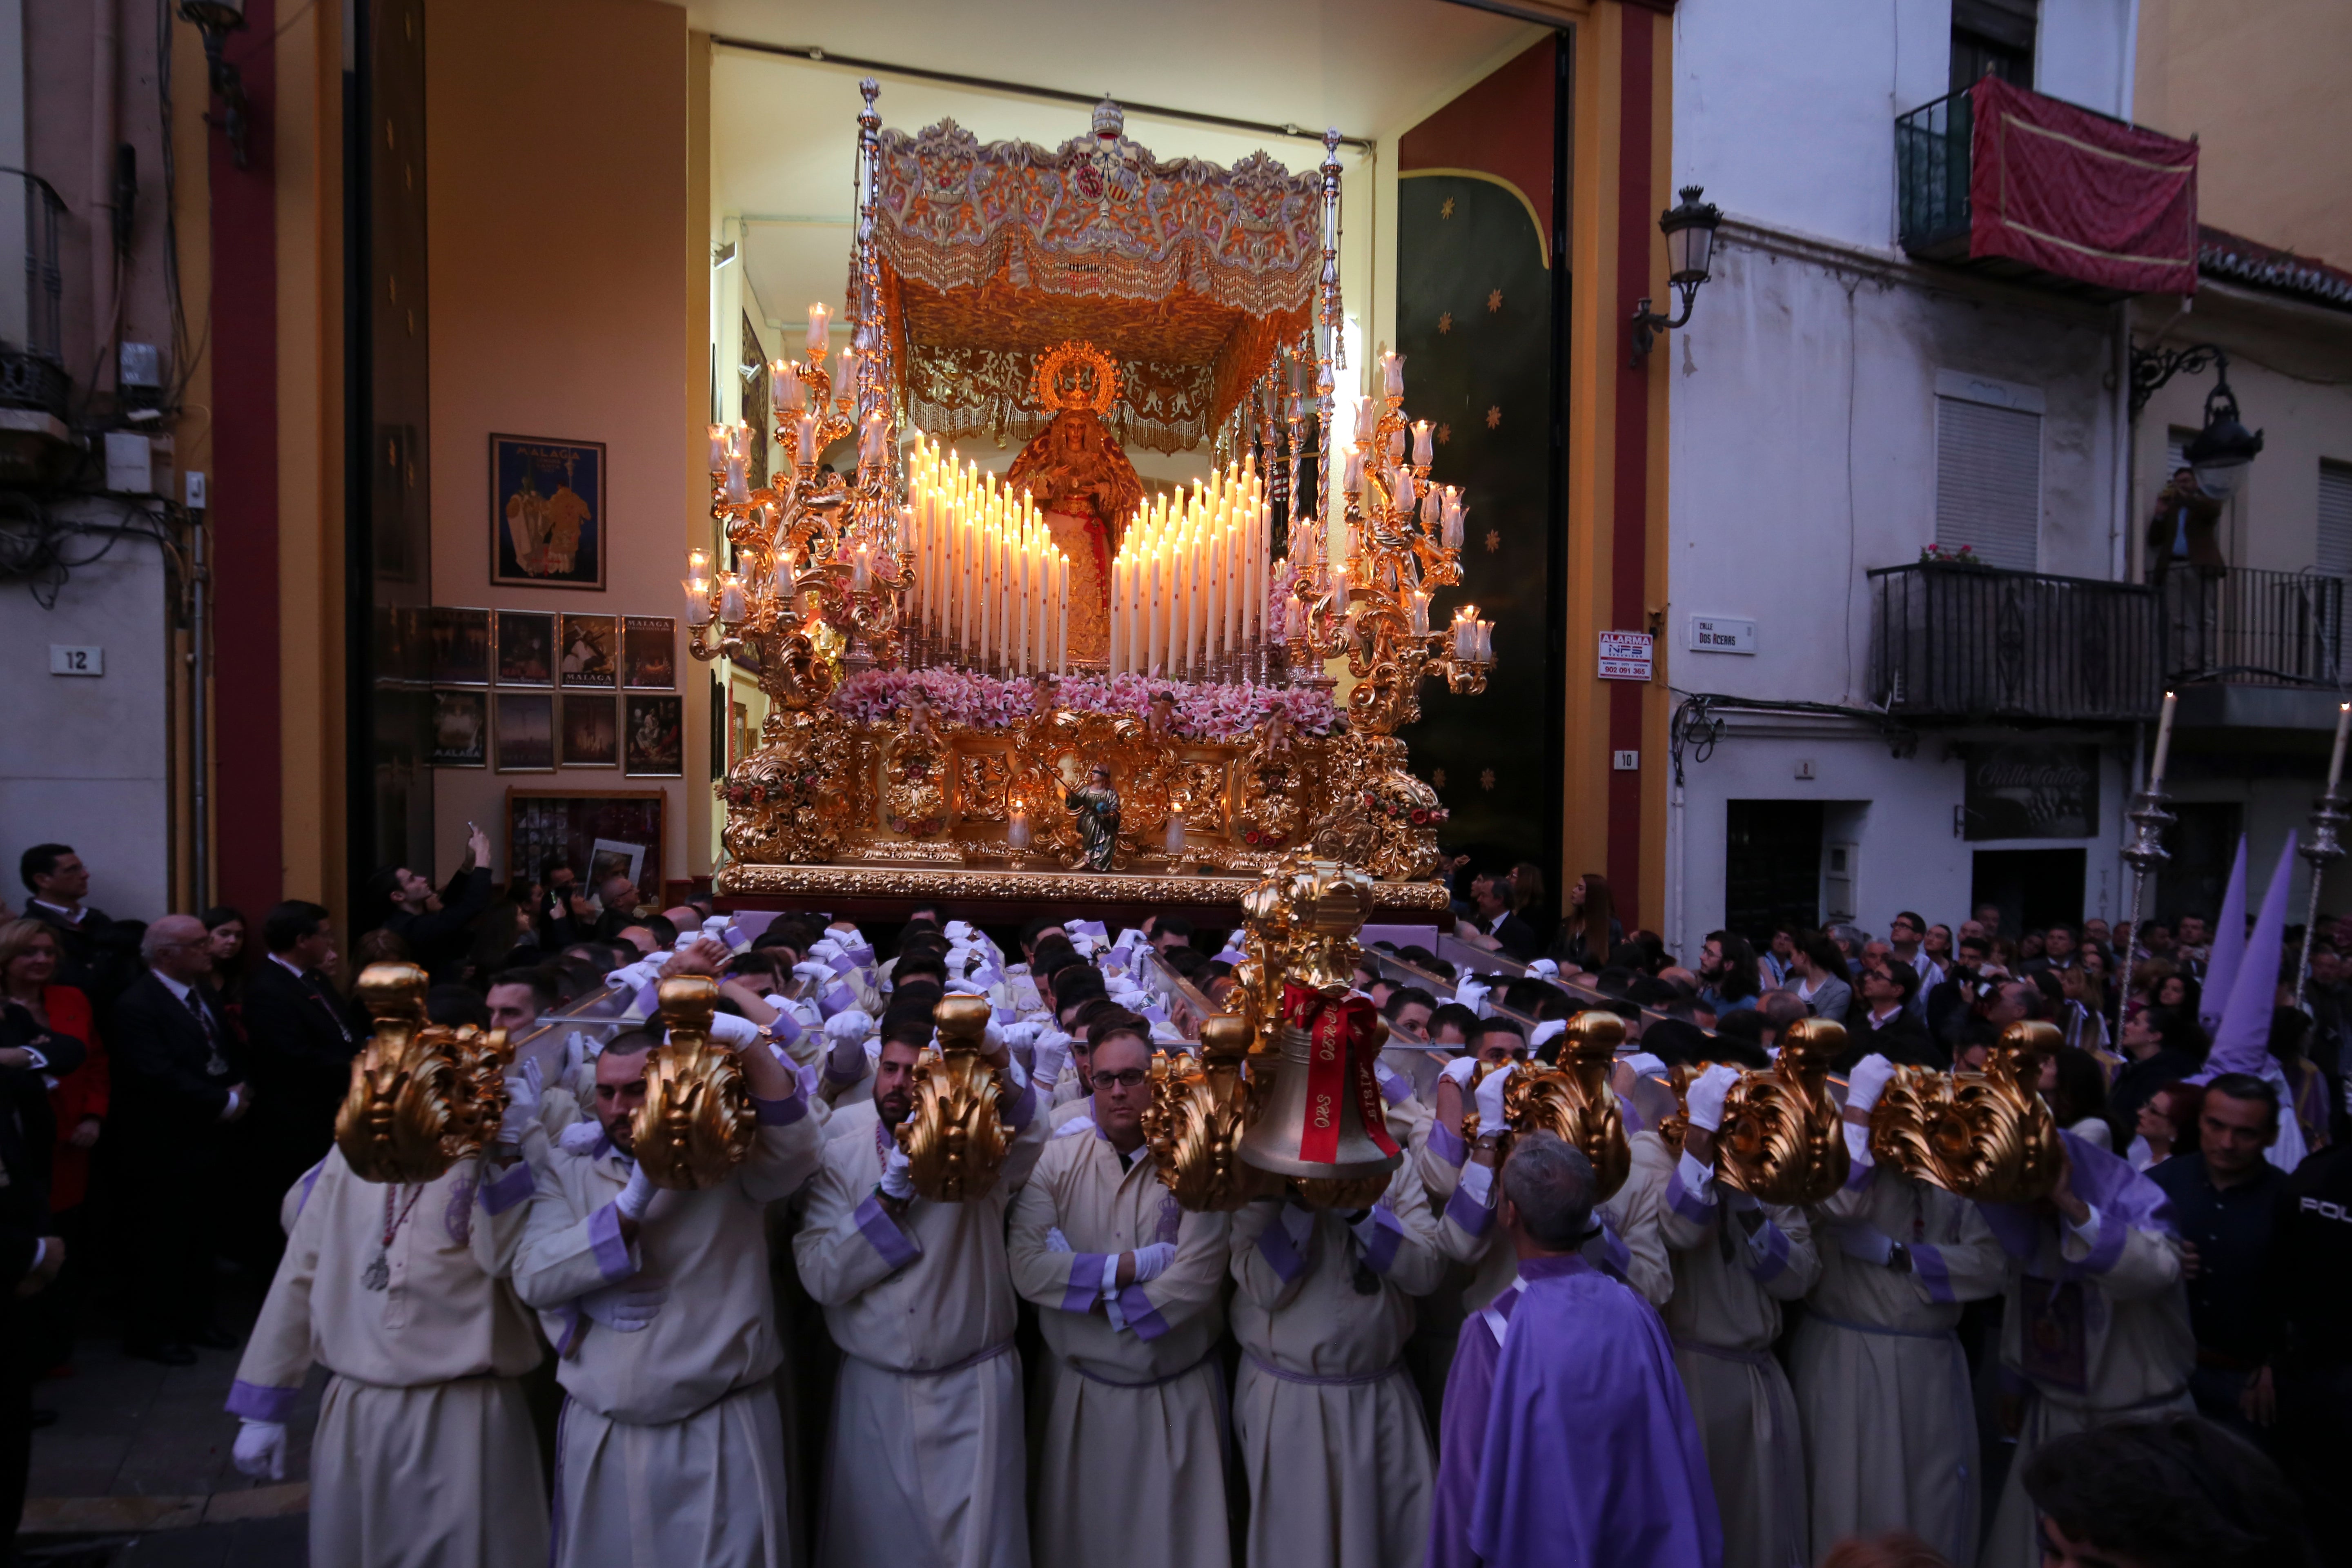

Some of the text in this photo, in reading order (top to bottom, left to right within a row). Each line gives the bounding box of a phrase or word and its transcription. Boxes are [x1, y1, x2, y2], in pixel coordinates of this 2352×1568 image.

[1602, 634, 1650, 645] ALARMA
[66, 651, 87, 669] 12
[1622, 754, 1632, 766] 10
[1804, 762, 1808, 775] 8
[2299, 1196, 2352, 1224] POL
